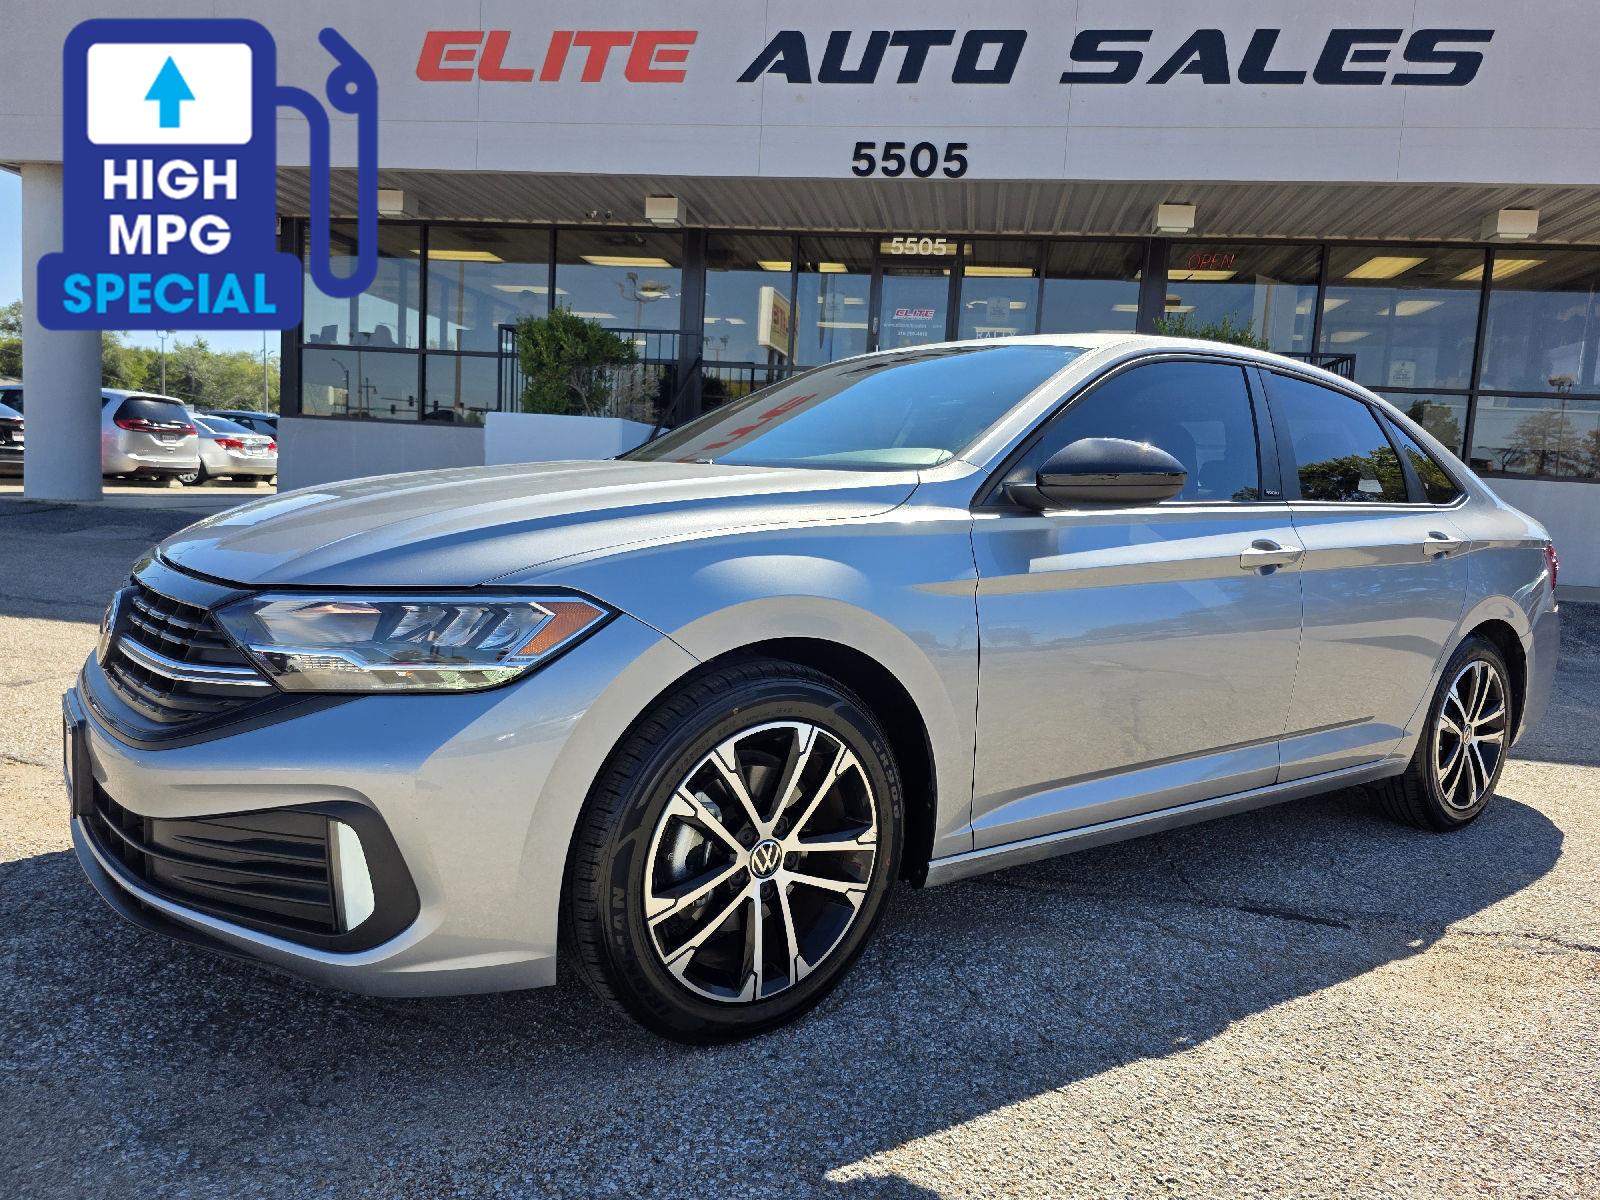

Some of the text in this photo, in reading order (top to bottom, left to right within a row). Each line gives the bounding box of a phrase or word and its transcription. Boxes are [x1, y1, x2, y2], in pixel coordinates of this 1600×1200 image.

[415, 28, 1496, 86] ELITE AUTO SALES
[851, 141, 968, 179] 5505
[891, 237, 947, 256] 5505
[1187, 253, 1236, 271] OPEN
[895, 308, 936, 319] ELITE
[750, 840, 783, 877] VW
